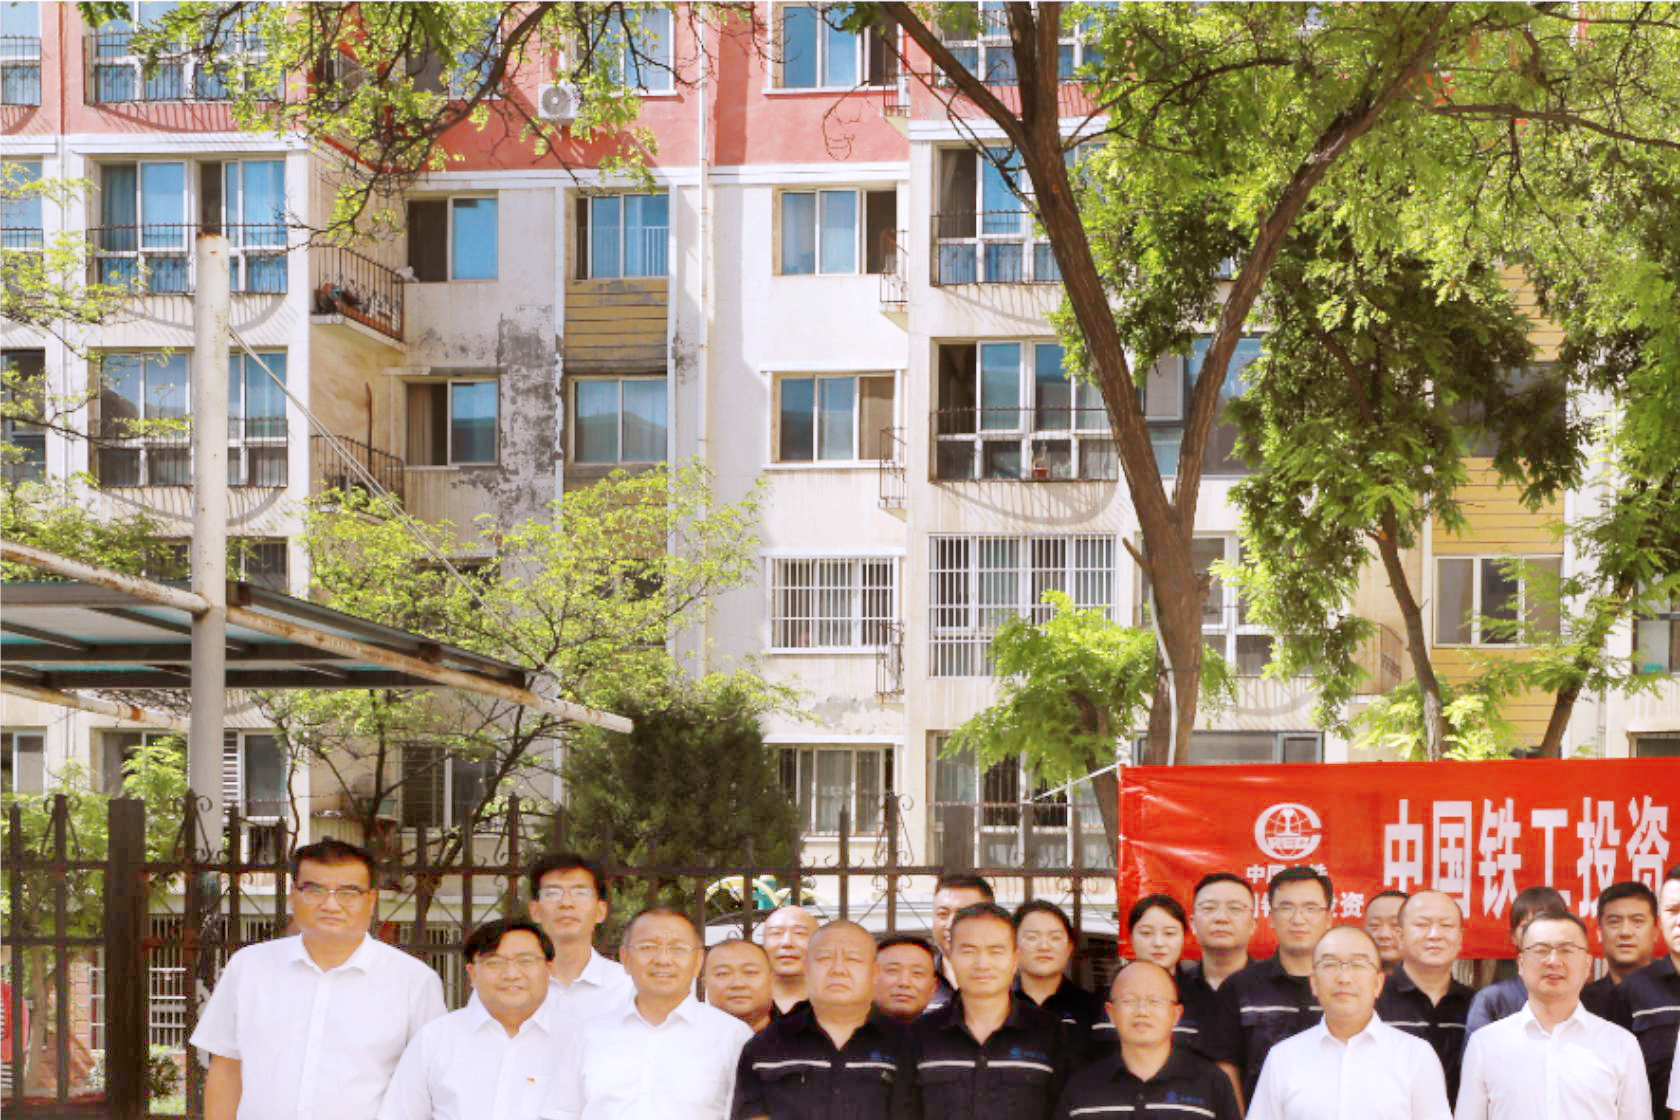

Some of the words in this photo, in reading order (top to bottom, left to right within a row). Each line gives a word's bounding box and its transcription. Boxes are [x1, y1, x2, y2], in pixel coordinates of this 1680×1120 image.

[1383, 795, 1670, 919] 中国铁工投资
